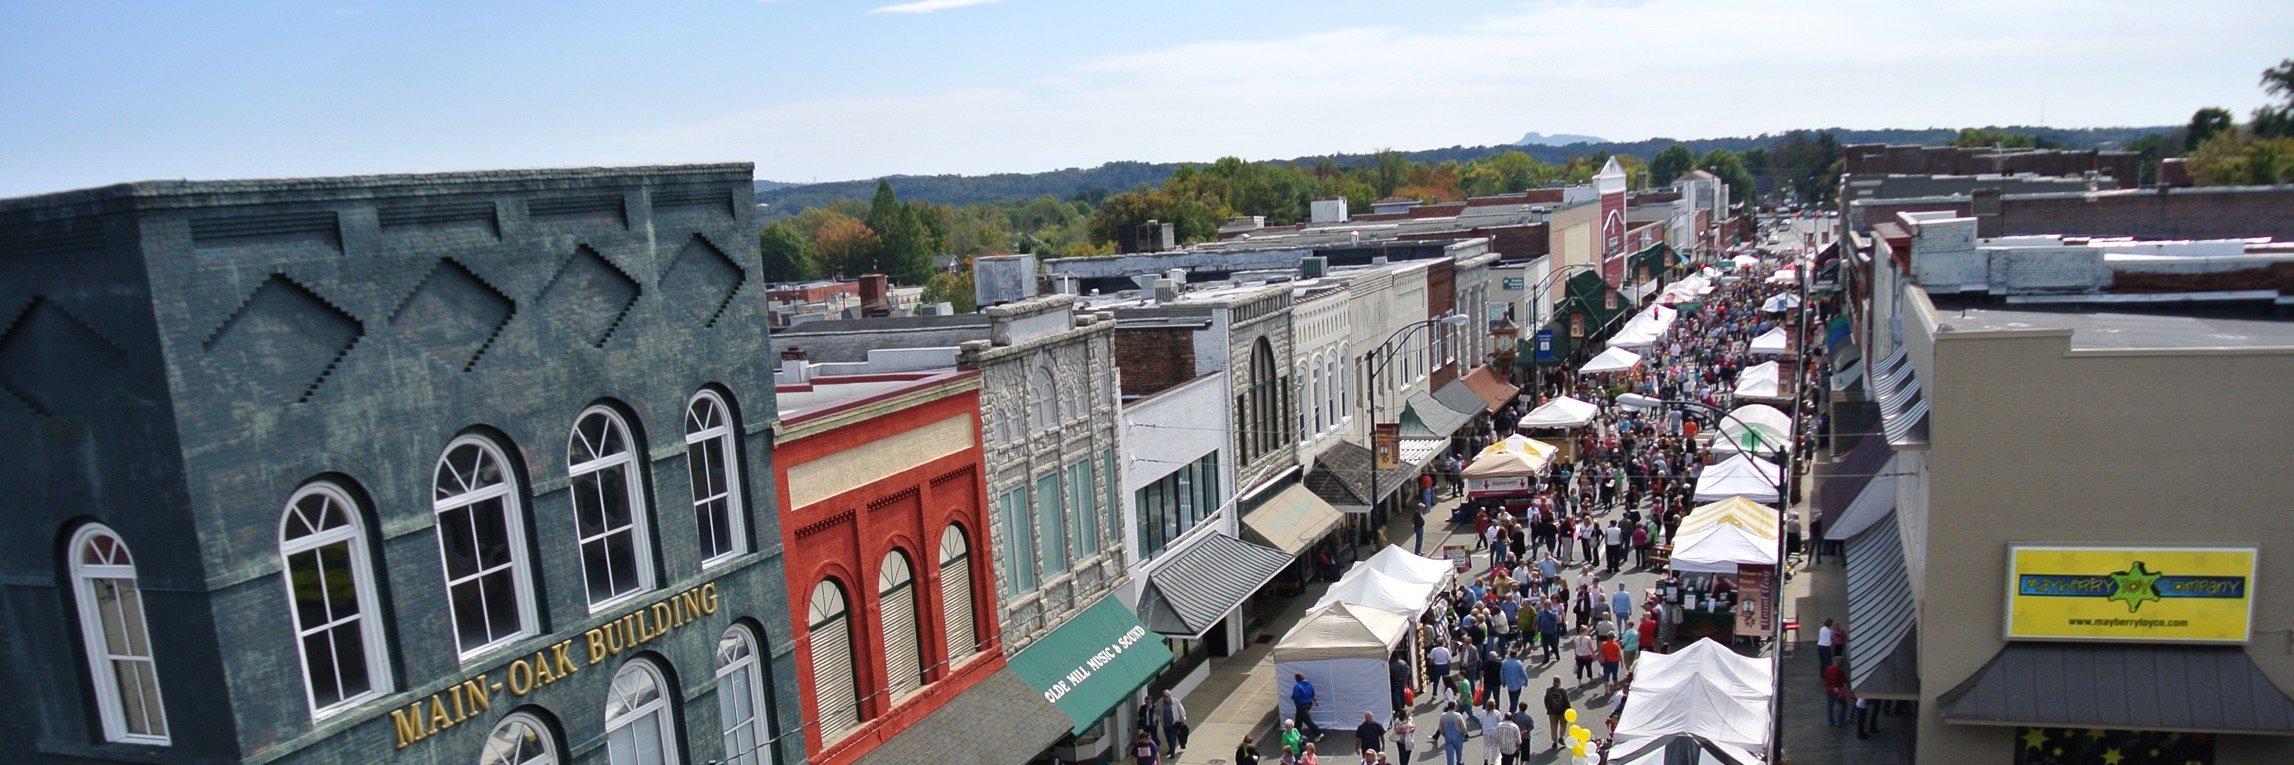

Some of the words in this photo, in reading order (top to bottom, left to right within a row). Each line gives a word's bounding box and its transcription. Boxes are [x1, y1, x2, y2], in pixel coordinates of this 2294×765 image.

[2068, 618, 2188, 628] www.mayberrytoyco.com
[390, 639, 578, 749] MAIN-OAK
[585, 582, 718, 665] BUILDING
[1044, 679, 1071, 704] OLDE
[1066, 665, 1092, 687] MILL
[1086, 646, 1116, 672] MUSIC
[1111, 643, 1122, 654] &
[1117, 625, 1146, 650] SOUND
